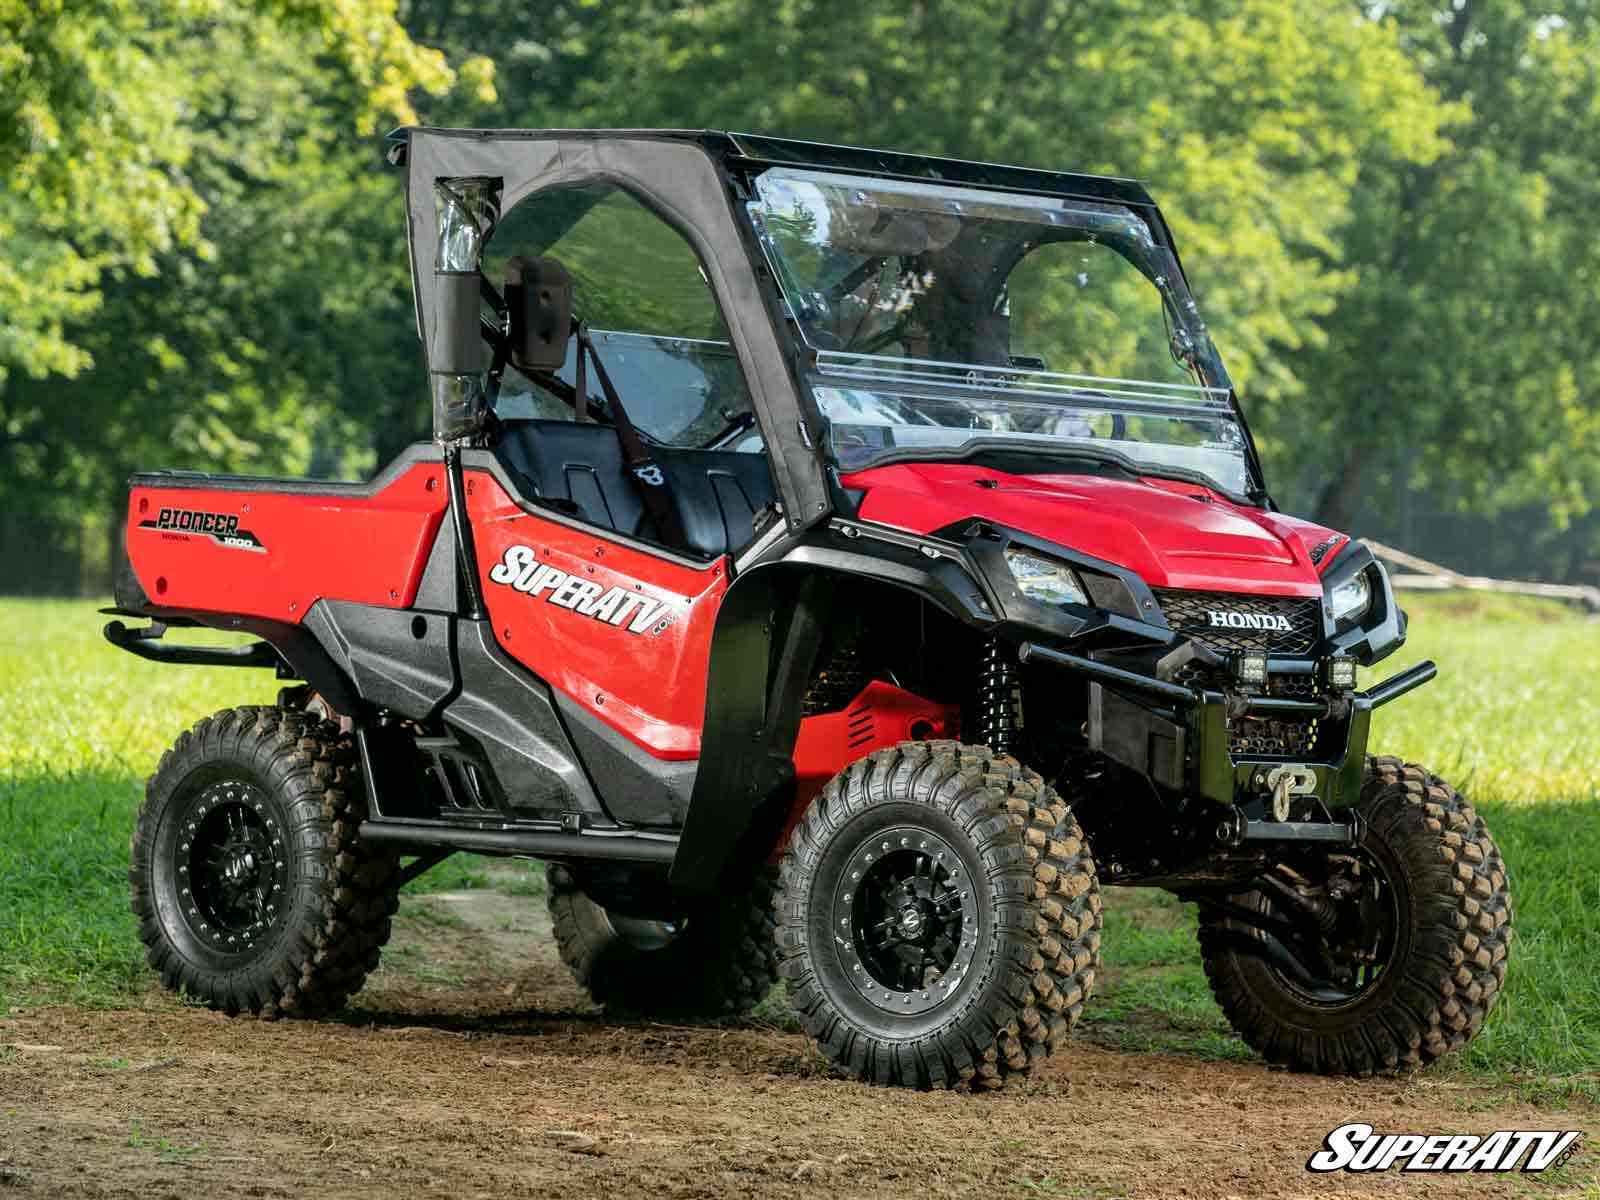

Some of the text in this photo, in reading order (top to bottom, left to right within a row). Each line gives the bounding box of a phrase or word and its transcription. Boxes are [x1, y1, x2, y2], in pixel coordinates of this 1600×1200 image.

[157, 507, 239, 536] PIONEER
[223, 536, 254, 548] 1000
[1207, 611, 1293, 631] HONDA
